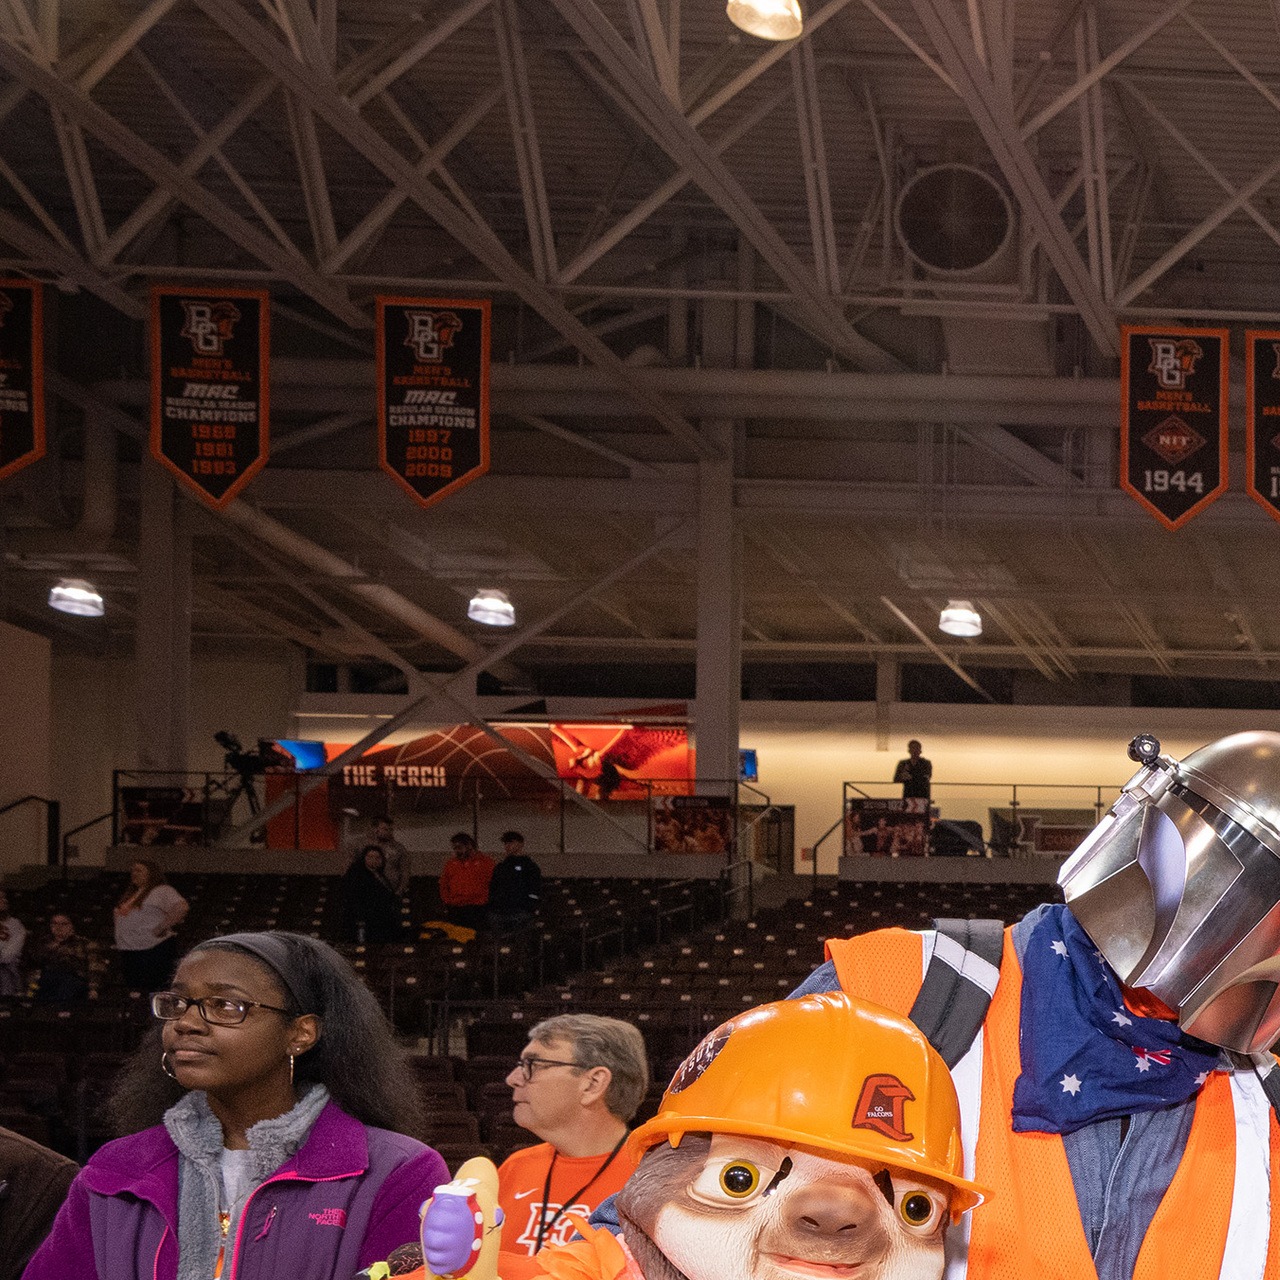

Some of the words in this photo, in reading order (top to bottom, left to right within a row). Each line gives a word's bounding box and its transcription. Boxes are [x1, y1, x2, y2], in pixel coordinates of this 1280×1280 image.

[183, 383, 239, 399] MAC
[404, 390, 458, 405] MAC
[166, 407, 256, 422] CHAMPIONS
[390, 414, 476, 429] CHAMPIONS
[1159, 435, 1190, 447] NIT
[406, 446, 453, 461] 2000
[1144, 470, 1203, 493] 1944
[343, 765, 377, 786] THE
